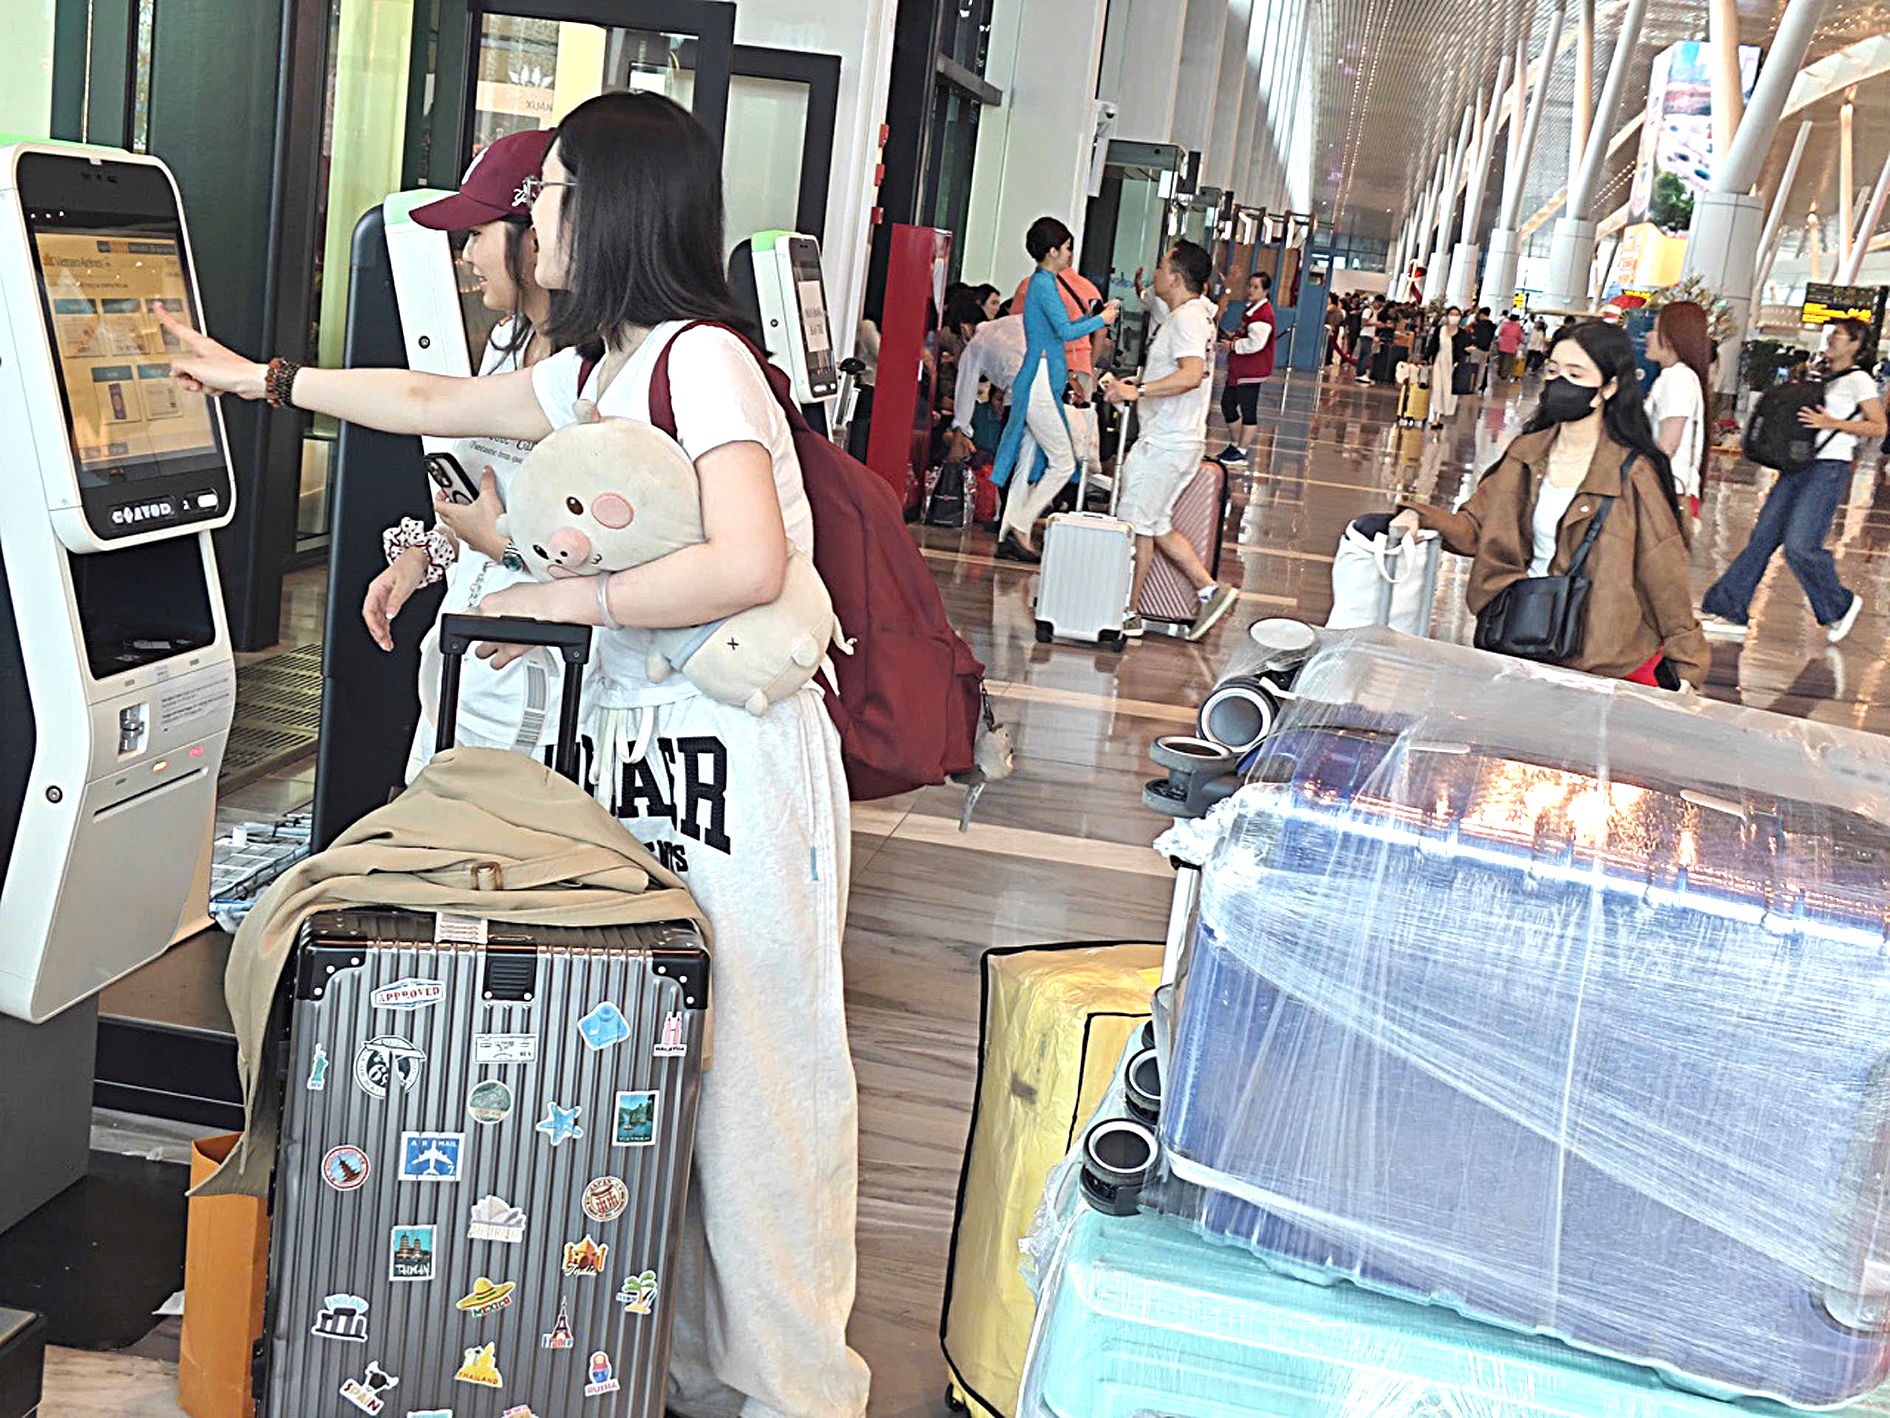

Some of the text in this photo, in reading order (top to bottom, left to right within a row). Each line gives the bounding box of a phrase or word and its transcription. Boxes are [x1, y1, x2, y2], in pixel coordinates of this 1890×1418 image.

[378, 986, 441, 1003] APPROVED
[472, 1296, 511, 1317] MEXICO
[459, 1371, 499, 1385] THAILAND
[343, 1382, 381, 1412] SPAIN
